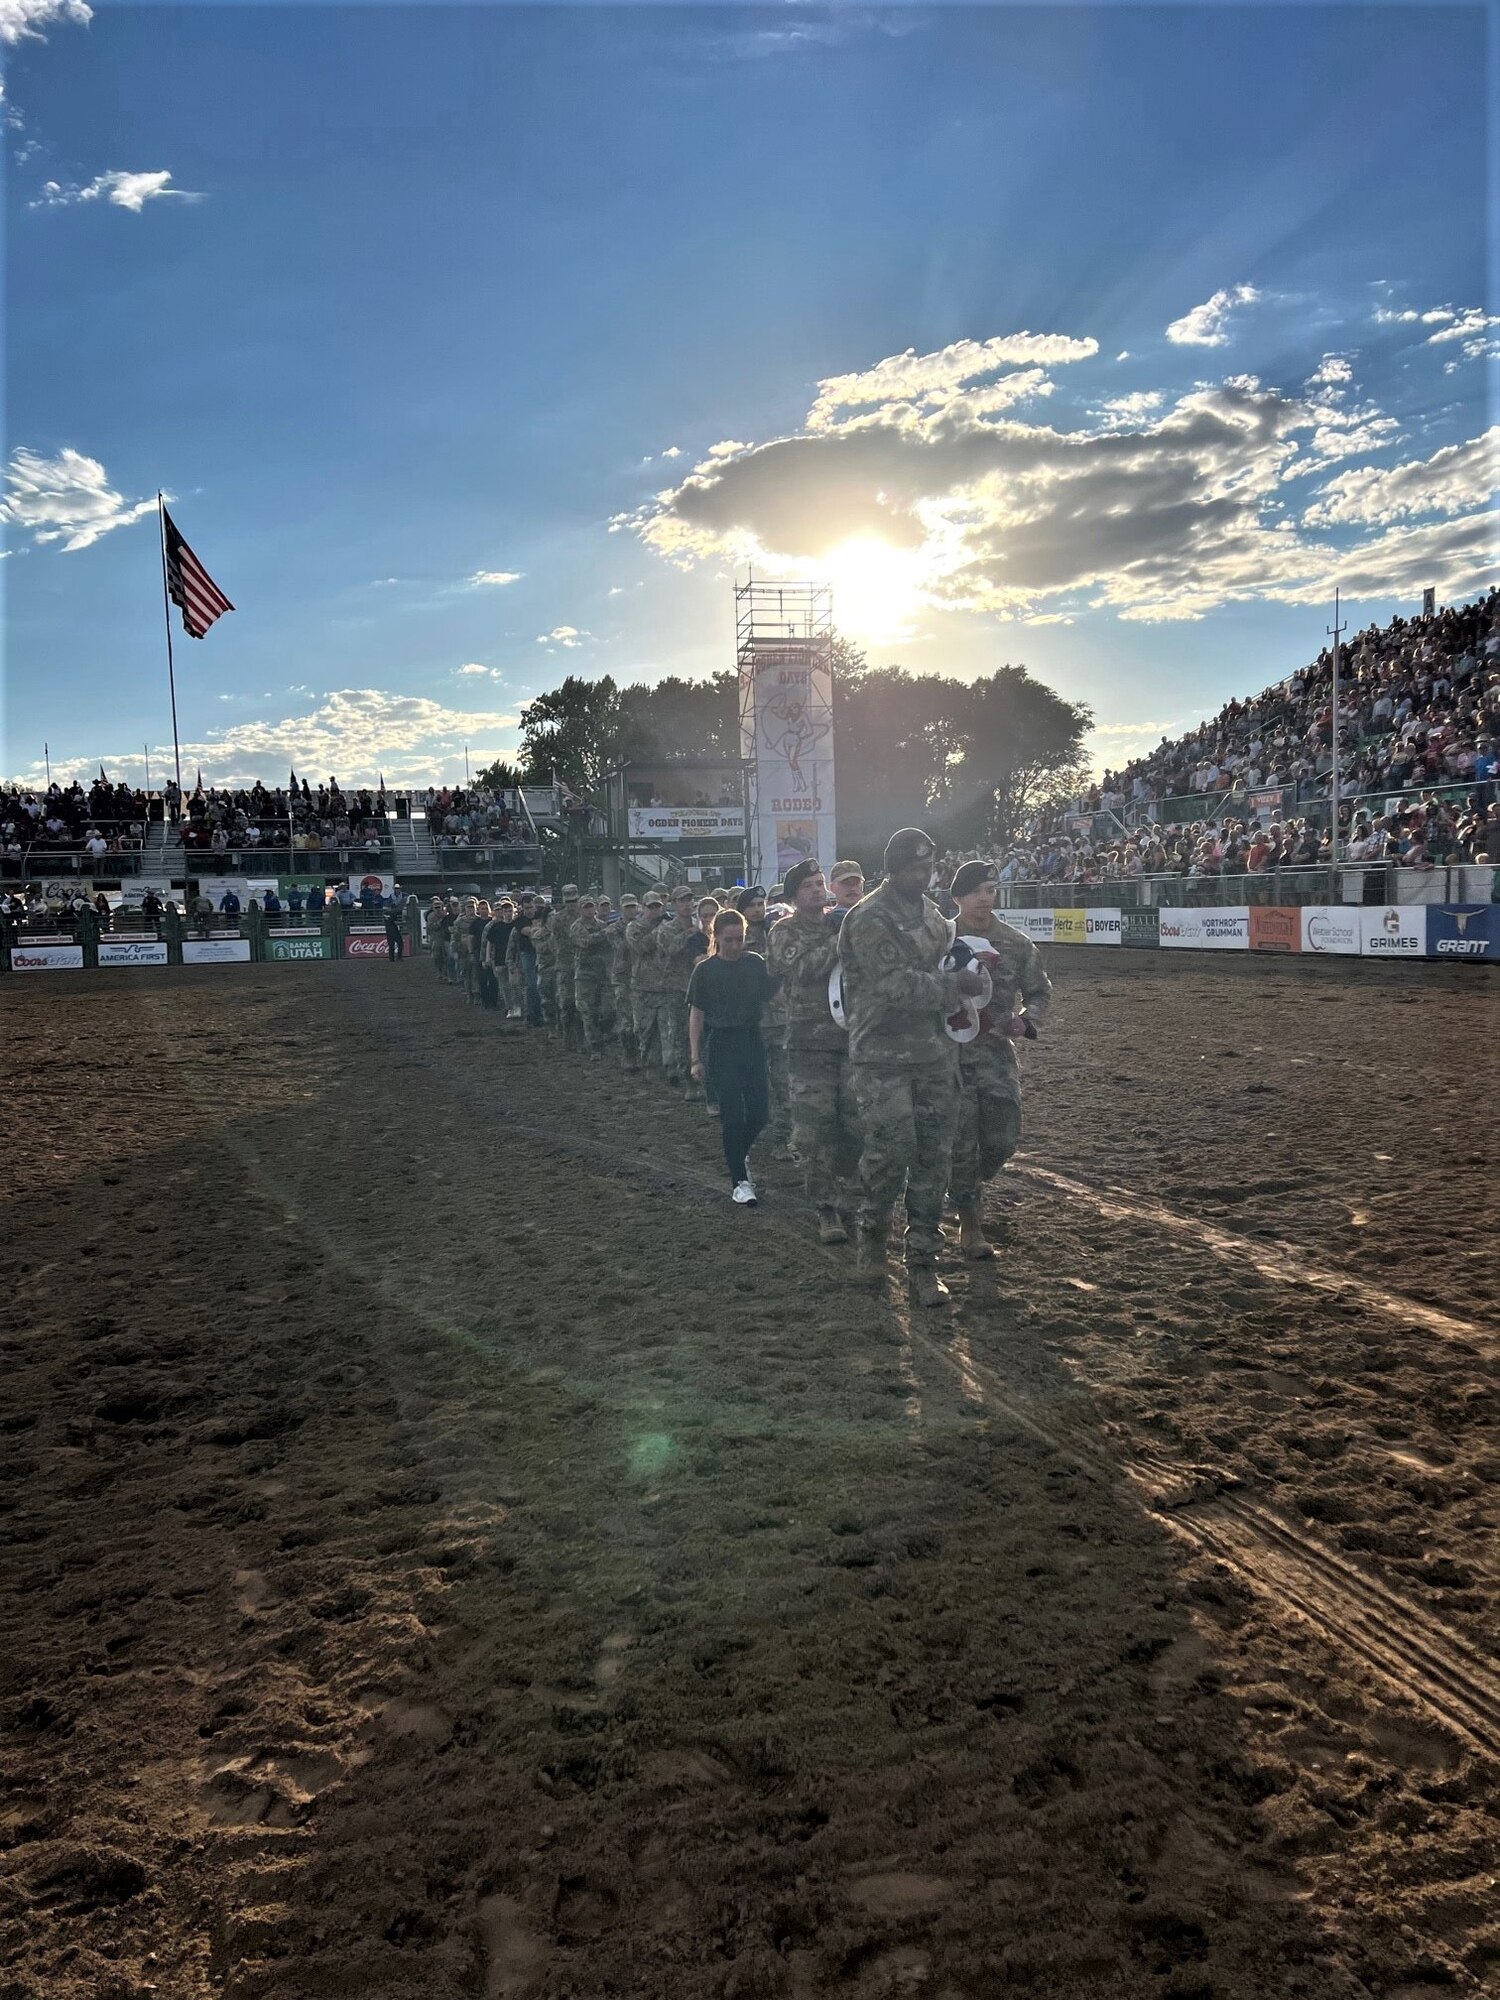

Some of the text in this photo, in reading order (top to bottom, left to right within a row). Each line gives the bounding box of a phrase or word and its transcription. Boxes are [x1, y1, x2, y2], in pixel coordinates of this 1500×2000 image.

[779, 671, 807, 685] DAYS
[771, 798, 822, 812] RODEO
[648, 817, 744, 828] OGDEN PIONEER DAYS
[1054, 918, 1073, 931] Hertz
[1095, 920, 1121, 932] BOYER
[1202, 918, 1238, 928] NORTHROP
[1206, 928, 1243, 938] GRUMMAN
[1331, 926, 1353, 937] School
[1370, 937, 1419, 948] GRIMES
[100, 952, 166, 962] AMERICA FIRST
[290, 948, 323, 958] UTAH
[14, 955, 49, 967] Coors
